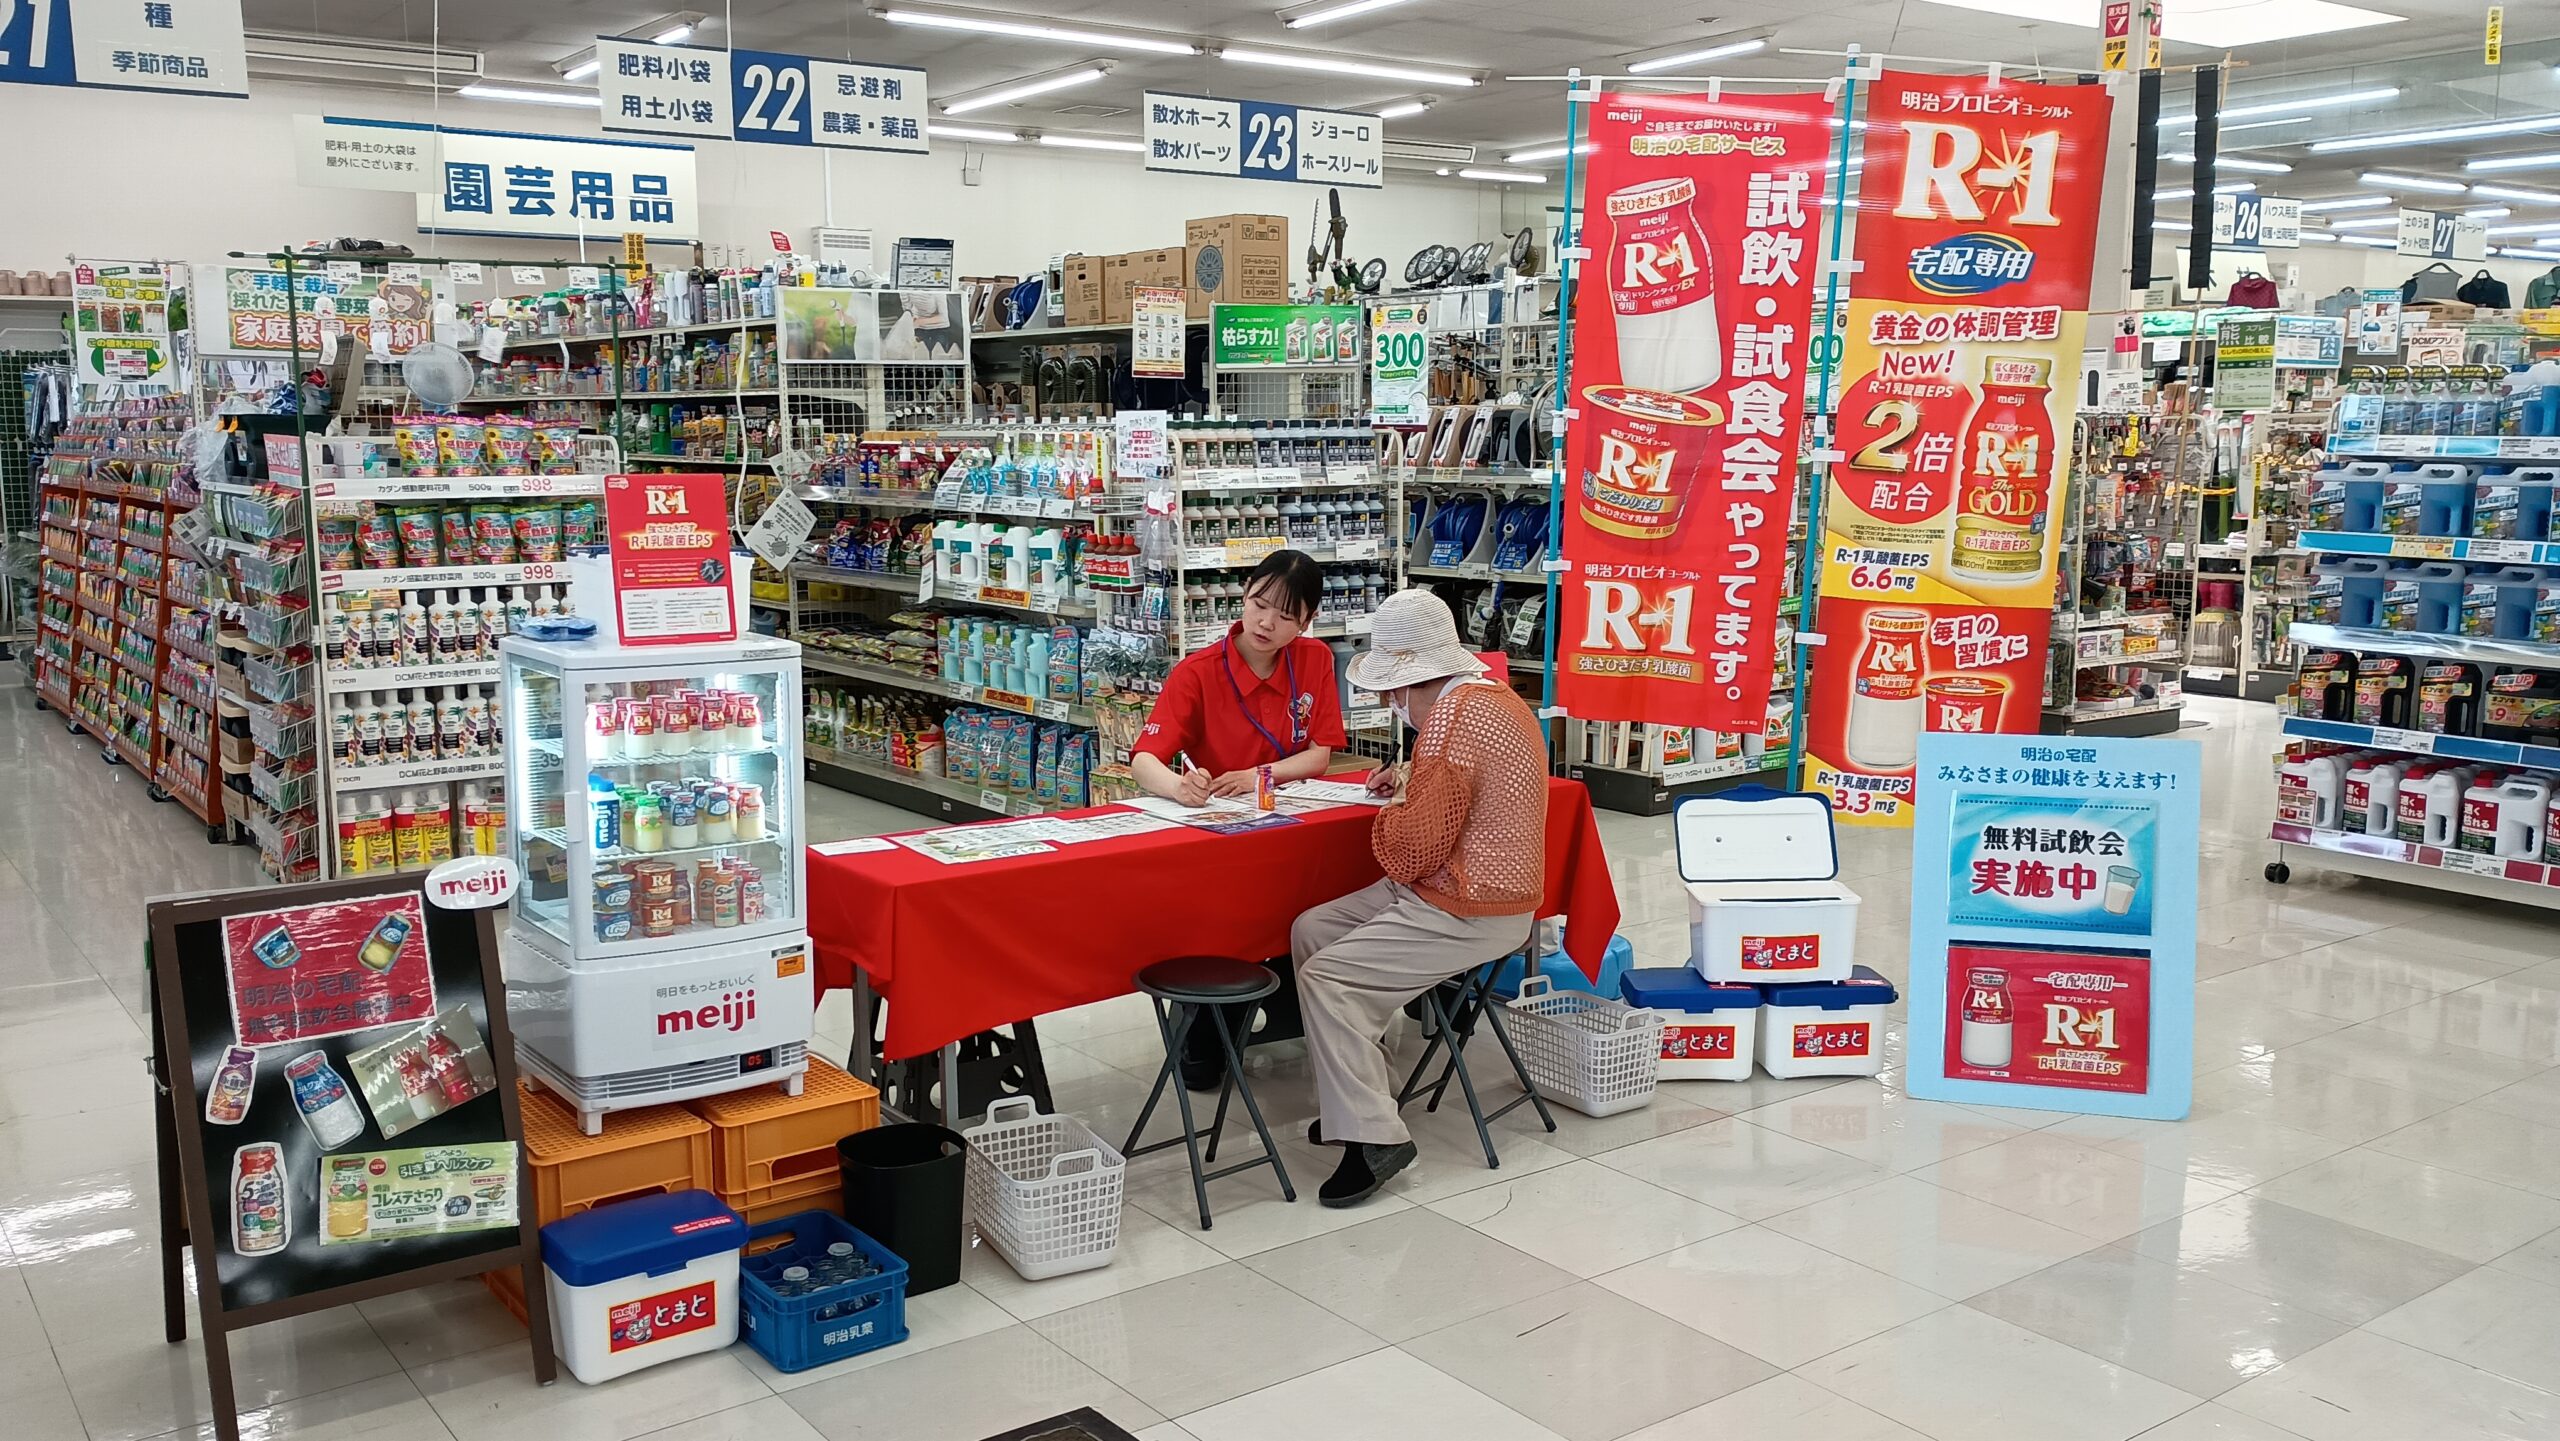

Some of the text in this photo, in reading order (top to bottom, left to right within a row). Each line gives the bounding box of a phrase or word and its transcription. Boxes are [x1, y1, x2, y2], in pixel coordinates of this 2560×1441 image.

[144, 2, 173, 28] 種
[112, 50, 209, 78] 季節商品
[618, 53, 711, 83] 肥料小袋
[738, 64, 806, 133] 22
[837, 74, 902, 100] 忌避剤
[621, 94, 713, 124] 用土小袋
[1152, 103, 1231, 129] 散水ホース
[1607, 109, 1643, 123] meiji
[822, 111, 919, 140] 農薬・薬品
[1311, 120, 1370, 142] ジョーロ
[1645, 120, 1777, 133] ご自宅までお届けいたします!
[325, 139, 417, 157] 肥料・用土の大袋は
[1152, 138, 1231, 162] 散水パーツ
[1243, 112, 1293, 171] 23
[1631, 135, 1786, 156] 明治の宅配サービス
[326, 156, 421, 173] 屋外にございます。
[1302, 152, 1379, 175] ホースリール
[1892, 121, 2061, 227] R-1
[444, 161, 674, 224] 園芸用品
[1639, 212, 1669, 227] meiji
[2234, 201, 2260, 240] 26
[2433, 218, 2455, 253] 27
[1622, 231, 1700, 288] R-1
[1911, 246, 2034, 280] 宅配専用
[1222, 327, 1280, 347] 枯らす力!
[1872, 309, 2059, 342] 黄金の体調管理
[2219, 323, 2241, 346] 熊
[2246, 324, 2272, 332] スプレー
[1375, 332, 1425, 368] 300
[1810, 334, 1844, 364] 00
[2243, 334, 2270, 346] 比較
[1882, 349, 1955, 378] New!
[1868, 380, 1955, 398] R-1乳酸菌EPS
[1997, 393, 2025, 407] meiji
[1629, 421, 1657, 435] meiji
[1596, 434, 1678, 493] R-1
[1973, 430, 2040, 479] R-1
[522, 478, 552, 493] 998
[1869, 480, 1934, 513] 配合
[1990, 478, 2015, 492] The
[645, 489, 690, 515] R-1
[1968, 486, 2037, 517] GOLD
[631, 533, 713, 549] R-1乳酸菌EPS
[1836, 547, 1930, 569] R-1乳酸菌EPS
[523, 565, 554, 579] 998
[1850, 566, 1916, 590] 6.6 mg
[1580, 580, 1697, 655] R-1
[1932, 616, 1999, 644] 毎日の
[1867, 641, 1917, 672] R-1
[1957, 636, 2028, 667] 習慣に
[1578, 657, 1692, 679] 強さひきだす乳酸菌
[1939, 704, 1985, 732] R-1
[2021, 747, 2096, 763] 明治の宅配
[1817, 770, 1912, 793] R-1乳酸菌EPS
[1937, 766, 2177, 790] みなさまの健康を支えます!
[1830, 789, 1897, 814] 3.3 mg
[598, 803, 610, 843] meiji
[1983, 825, 2125, 857] 無料試飲会
[439, 869, 508, 896] meiji
[1971, 858, 2097, 900] 実施中
[1743, 937, 1766, 947] meiji
[1775, 942, 1815, 961] とまと
[243, 972, 367, 1008] 明治の宅配
[656, 974, 755, 999] 明日をもっとおいしく
[1972, 989, 2004, 1009] R-1
[657, 989, 756, 1035] meiji
[1795, 1025, 1817, 1035] meiji
[1824, 1030, 1864, 1048] とまと
[2042, 1003, 2121, 1050] R-1
[1689, 1032, 1729, 1051] とまと
[2039, 1057, 2121, 1075] R-1乳酸菌EPS
[371, 1163, 385, 1171] NEW
[371, 1187, 444, 1208] コレステさらり
[611, 1302, 642, 1319] meiji
[654, 1294, 708, 1327] とまと
[823, 1321, 875, 1346] 明治乳業
